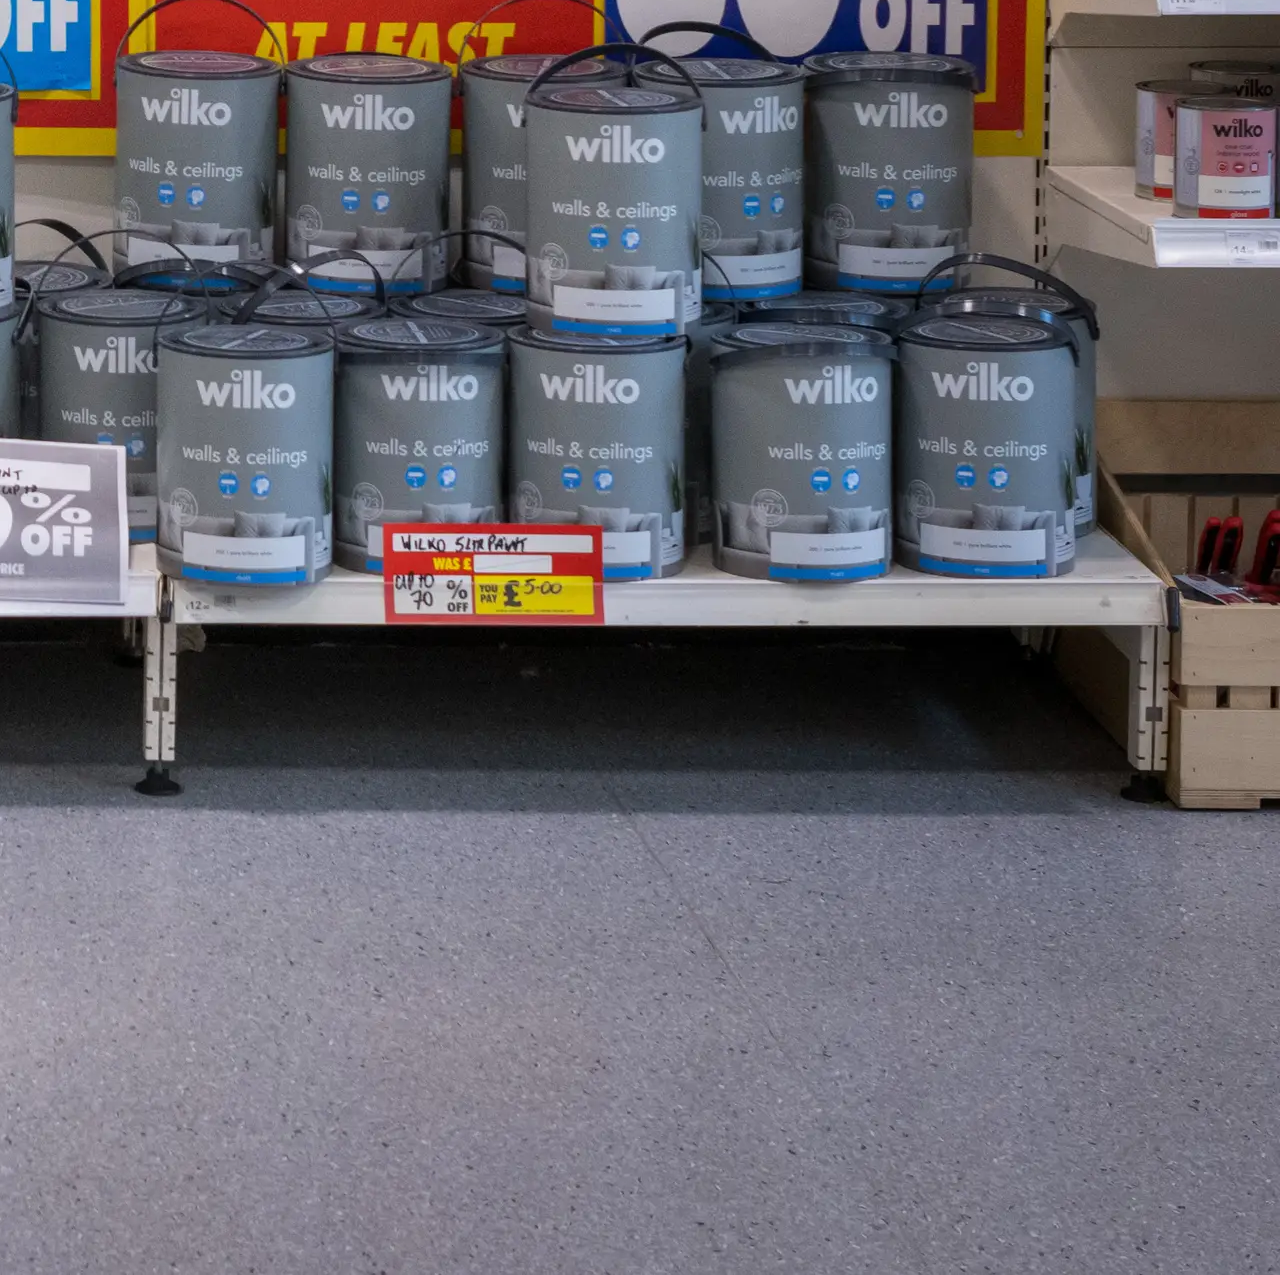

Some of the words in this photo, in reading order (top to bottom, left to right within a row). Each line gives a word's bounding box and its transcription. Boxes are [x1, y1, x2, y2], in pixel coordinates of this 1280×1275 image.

[321, 95, 415, 131] wilko
[566, 125, 666, 163] wilko
[932, 363, 1034, 402] wilko
[918, 438, 956, 454] walls
[962, 441, 977, 457] &
[983, 441, 1047, 460] ceilings
[20, 524, 93, 557] OFF
